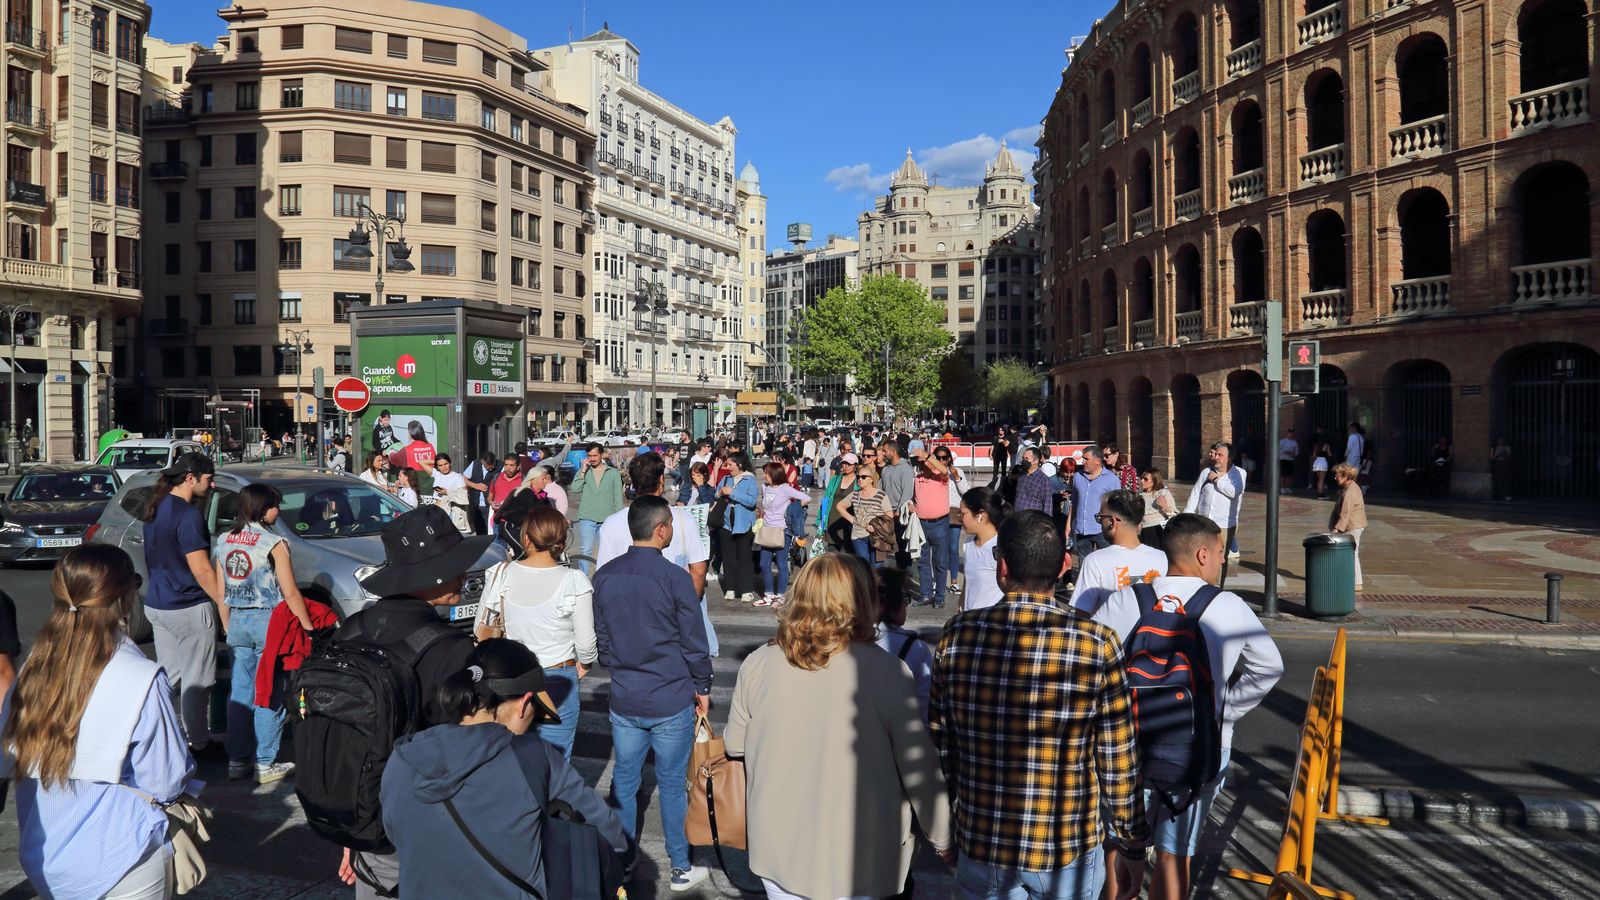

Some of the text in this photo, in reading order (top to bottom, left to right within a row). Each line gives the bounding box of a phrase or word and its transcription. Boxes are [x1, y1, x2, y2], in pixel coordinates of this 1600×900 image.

[362, 366, 396, 375] Cuando
[372, 383, 412, 394] aprendes
[458, 605, 478, 617] 8162
